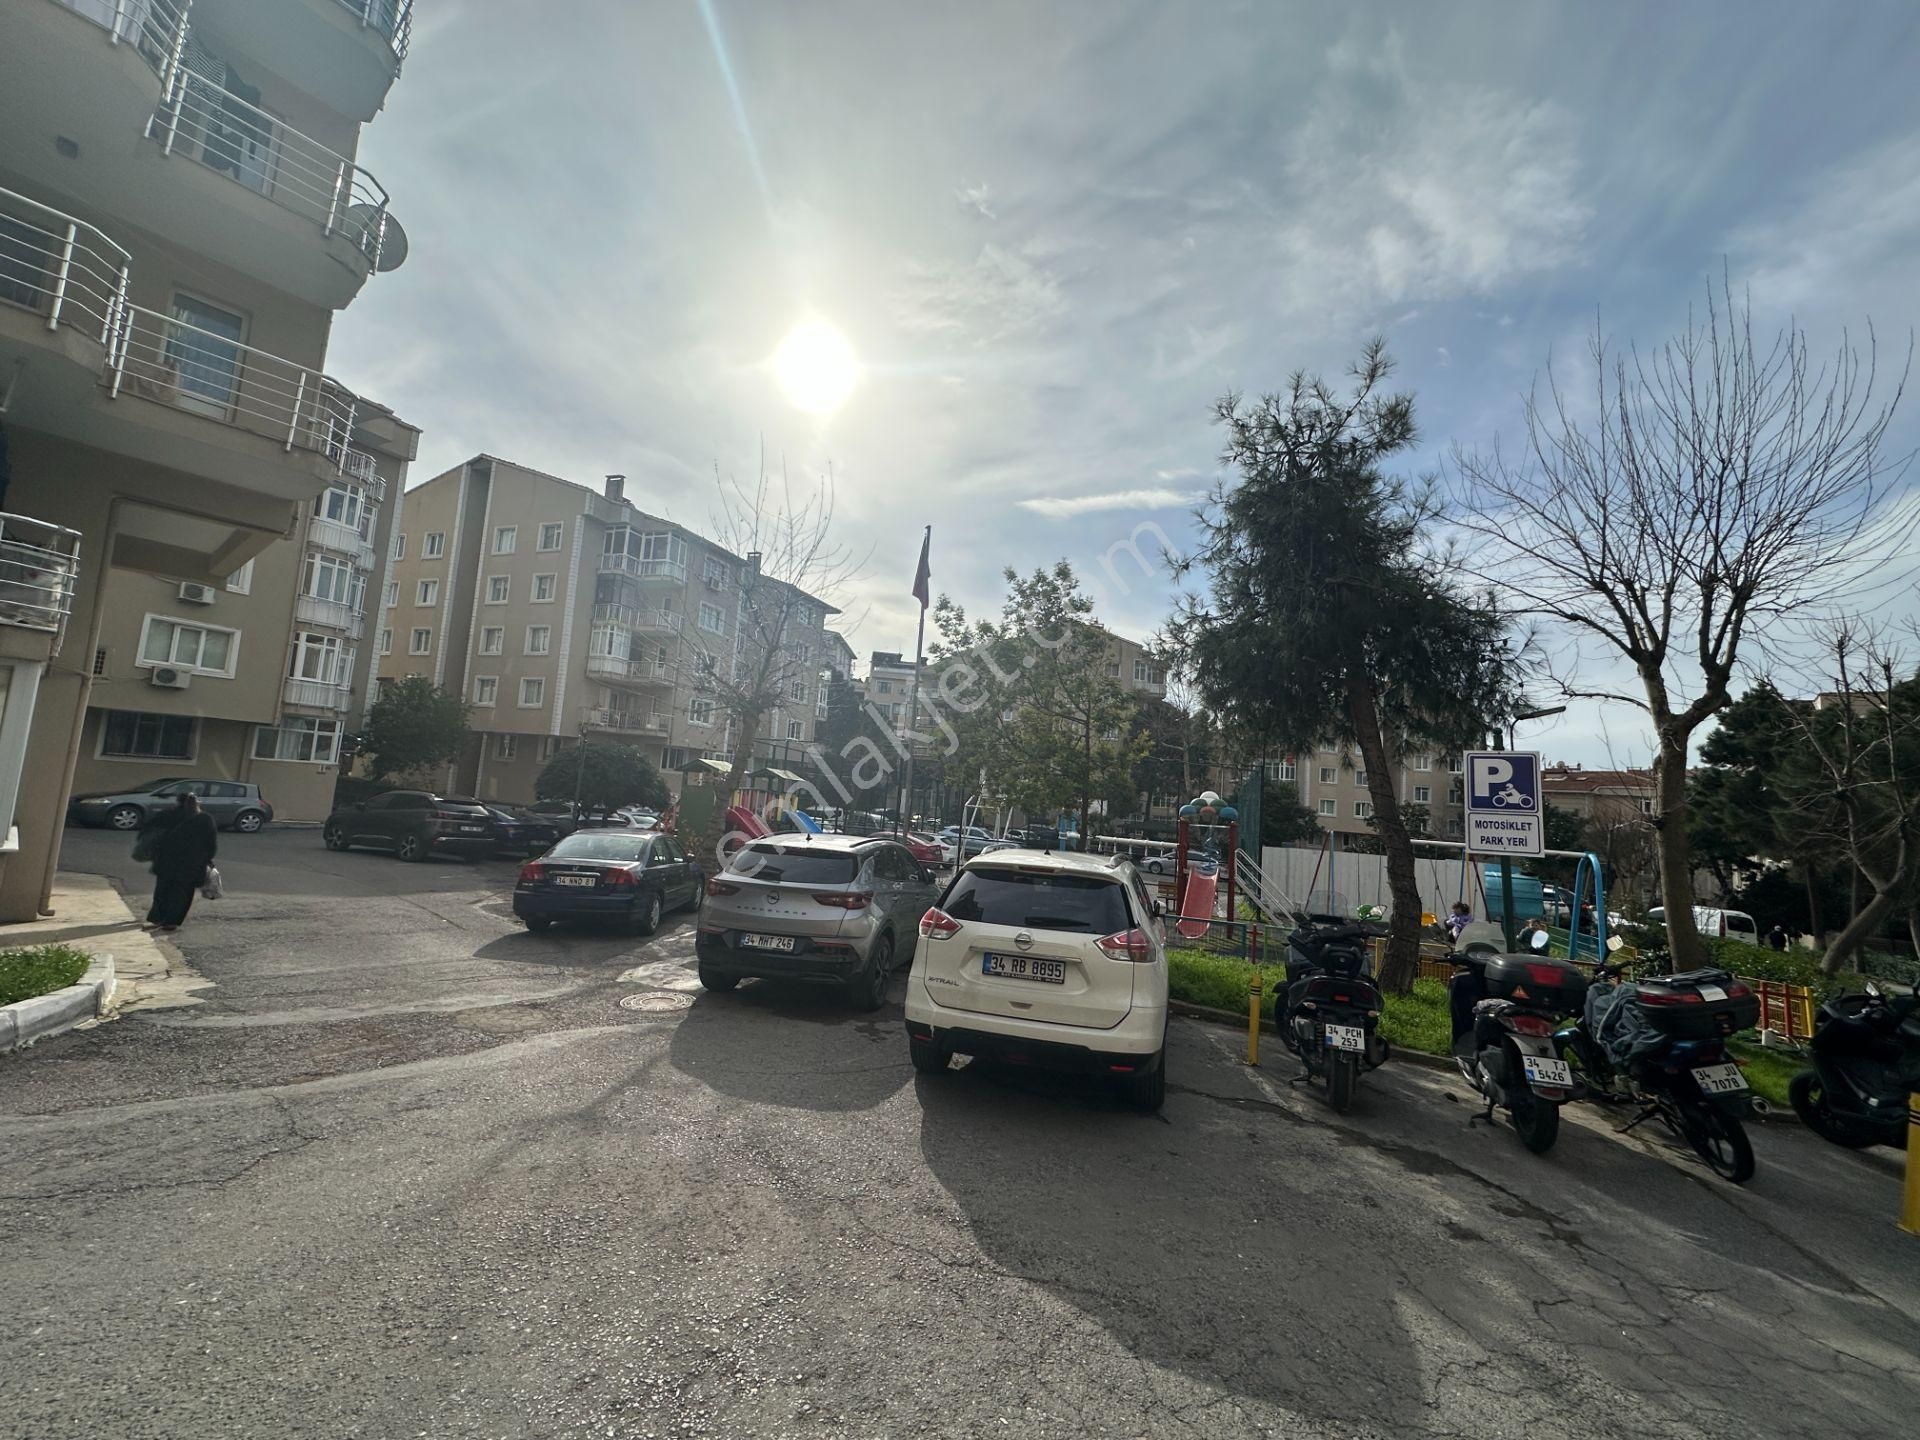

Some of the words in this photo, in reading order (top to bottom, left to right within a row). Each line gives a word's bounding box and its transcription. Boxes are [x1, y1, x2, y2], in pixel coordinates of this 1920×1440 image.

[1473, 758, 1513, 797] P
[1474, 819, 1533, 832] MOTOSİKLET
[1480, 835, 1505, 846] PARK
[1506, 836, 1528, 847] YERİ
[745, 934, 755, 945] 34
[776, 937, 793, 949] 246
[991, 956, 1006, 971] 34
[1011, 959, 1027, 973] RB
[1031, 961, 1062, 977] 8895
[1327, 1025, 1339, 1036] 34
[1345, 1027, 1362, 1039] PCH
[1341, 1037, 1358, 1048] 253
[1526, 1057, 1540, 1068] 34
[1552, 1060, 1567, 1072] TJ
[1538, 1069, 1565, 1082] 5426
[1695, 1069, 1711, 1081] 34
[1723, 1064, 1738, 1076] JU
[1711, 1077, 1740, 1091] 7078
